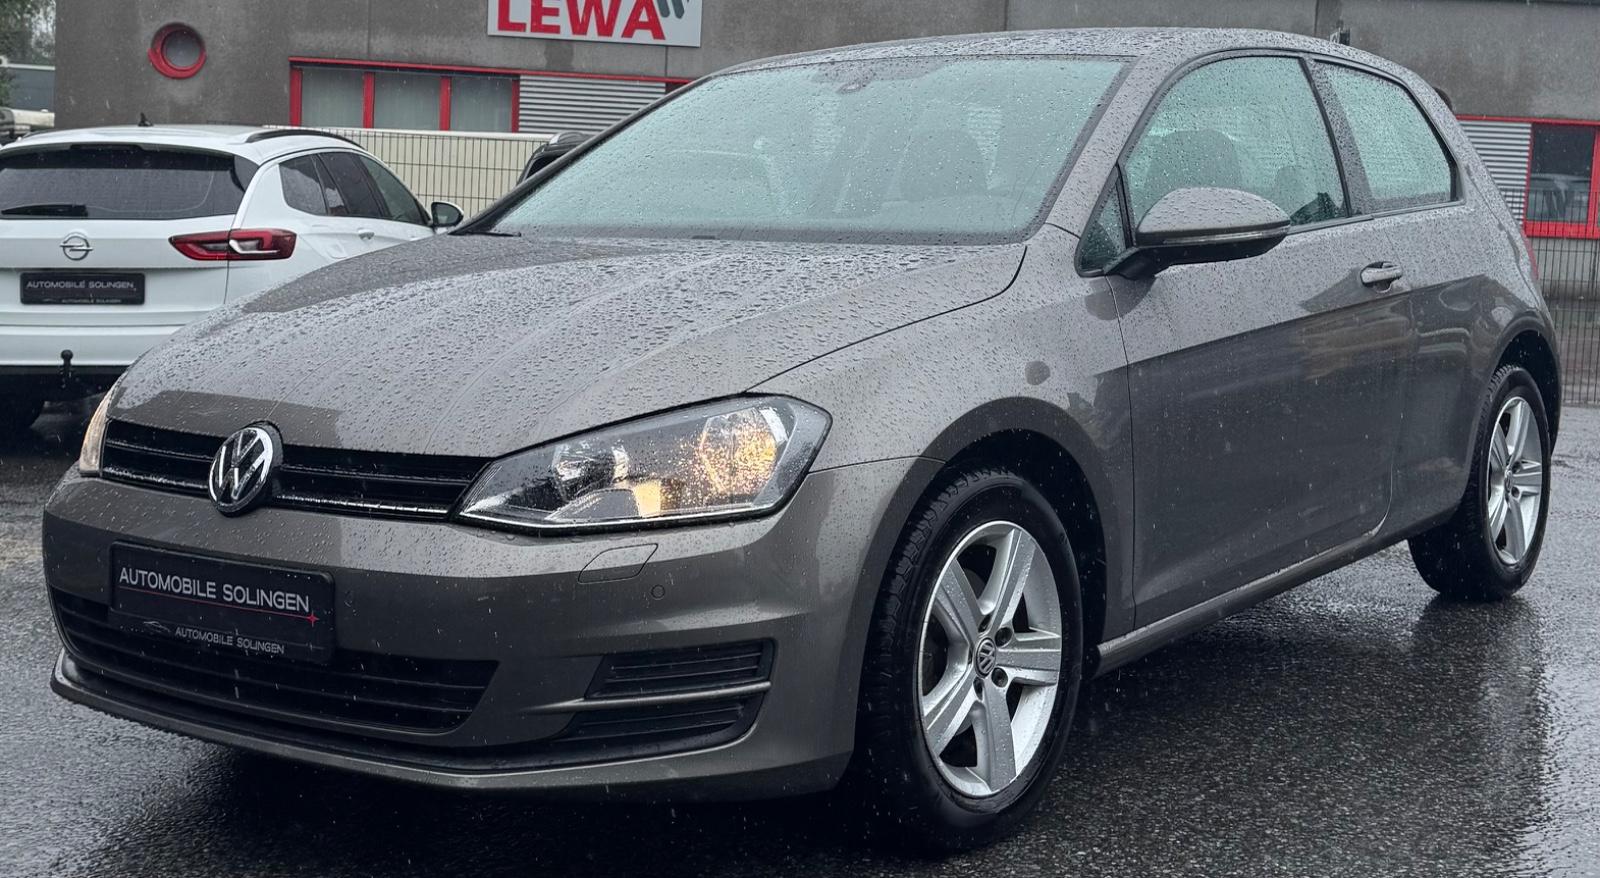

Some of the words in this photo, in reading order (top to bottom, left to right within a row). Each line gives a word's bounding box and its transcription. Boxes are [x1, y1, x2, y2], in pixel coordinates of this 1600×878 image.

[498, 0, 666, 40] LEWA
[26, 281, 85, 289] AUTOMOBILE
[88, 281, 134, 289] SOLINGEN
[209, 427, 273, 512] VW
[119, 567, 217, 599] AUTOMOBILE
[222, 584, 310, 613] SOLINGEN
[175, 627, 233, 645] AUTOMOBILE
[236, 637, 285, 655] SOLINGEN
